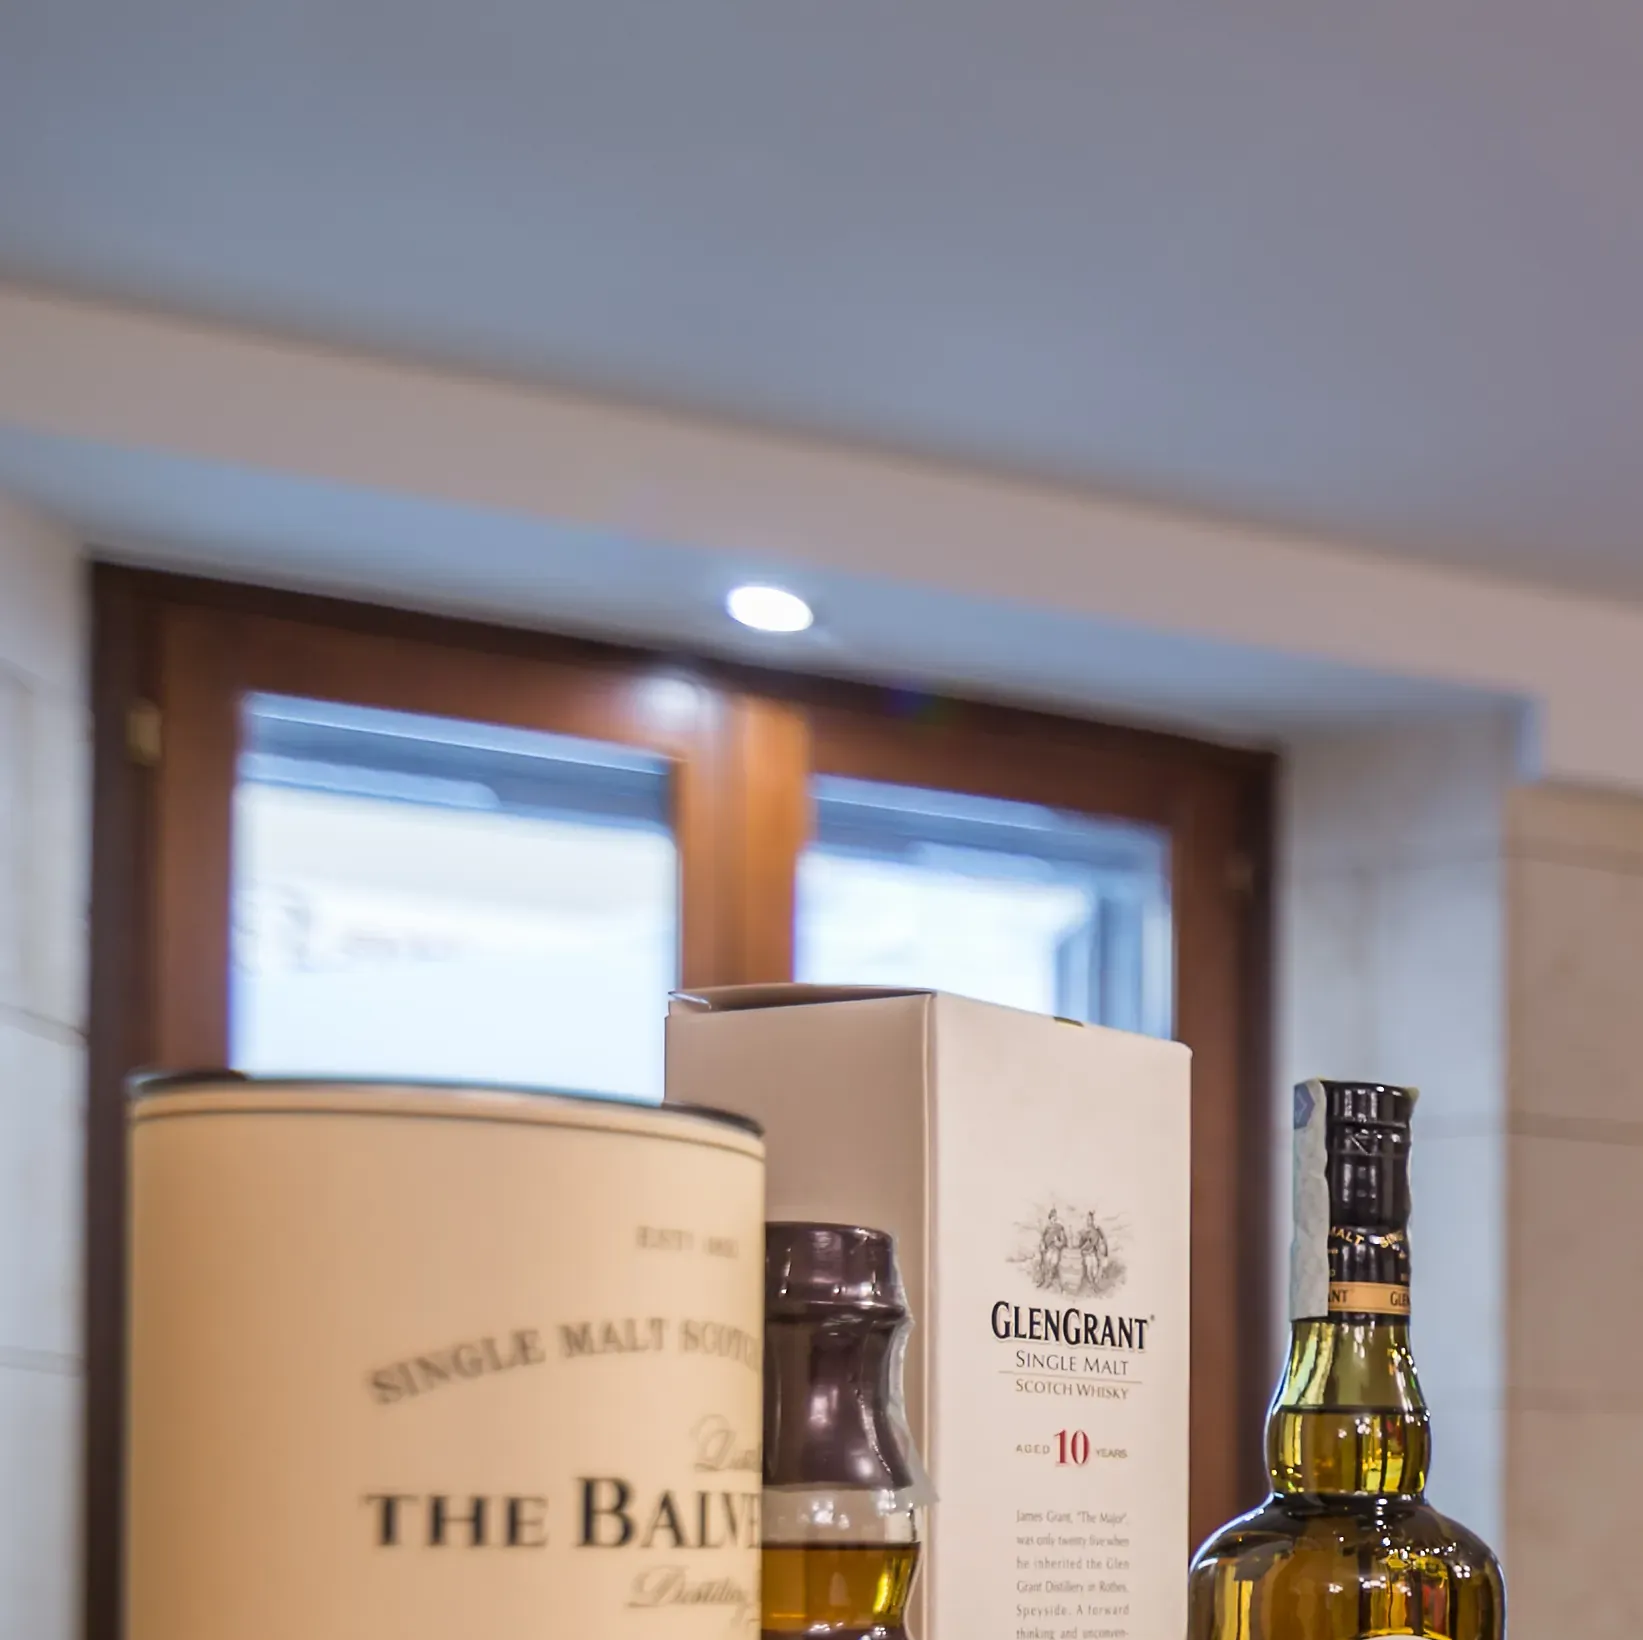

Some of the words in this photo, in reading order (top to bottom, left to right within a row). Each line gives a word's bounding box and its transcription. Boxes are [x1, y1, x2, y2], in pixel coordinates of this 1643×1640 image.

[991, 1300, 1148, 1350] GLENGRANT
[370, 1328, 546, 1405] SINGLE
[556, 1317, 667, 1360] MALT
[1016, 1350, 1077, 1372] SINGLE
[1084, 1357, 1129, 1376] MALT
[1015, 1379, 1072, 1396] SCOTCH
[1076, 1383, 1129, 1401] WHISKY
[1015, 1443, 1050, 1455] AGED
[1053, 1429, 1090, 1467] 10
[1096, 1447, 1128, 1460] YEARS
[364, 1493, 549, 1552] THE
[1016, 1509, 1043, 1523] James
[1016, 1536, 1034, 1546] was
[1016, 1556, 1030, 1570] he
[1033, 1556, 1083, 1570] inherited
[1086, 1556, 1101, 1570] the
[1106, 1556, 1130, 1570] Glen
[1016, 1581, 1042, 1594] Grant
[1045, 1580, 1084, 1595] Distillery
[1076, 1603, 1083, 1616] A
[1088, 1603, 1130, 1616] forward
[1060, 1627, 1077, 1640] and
